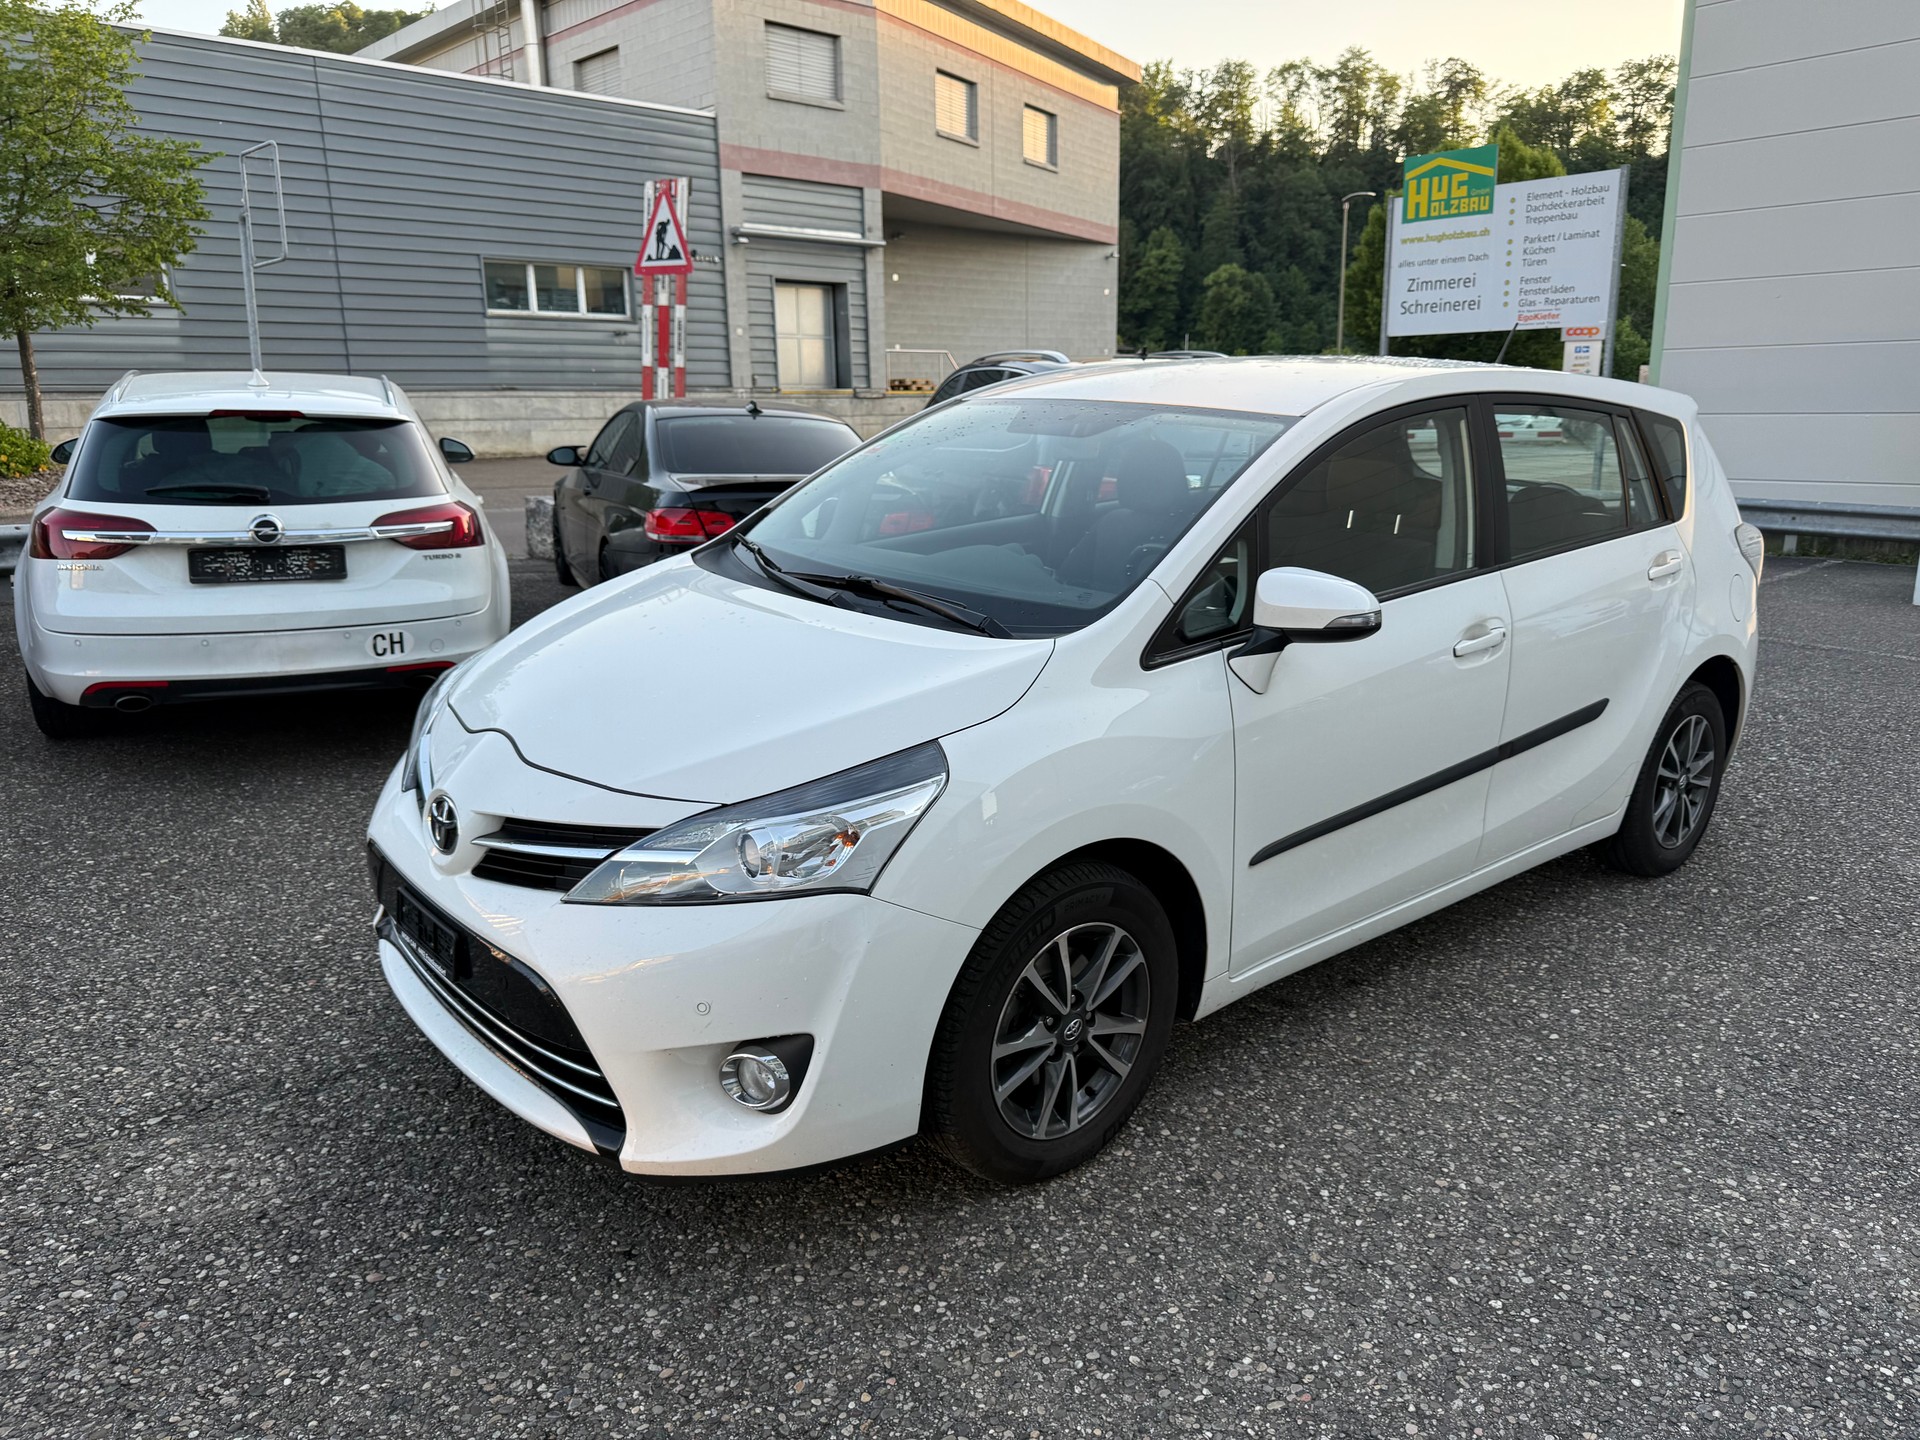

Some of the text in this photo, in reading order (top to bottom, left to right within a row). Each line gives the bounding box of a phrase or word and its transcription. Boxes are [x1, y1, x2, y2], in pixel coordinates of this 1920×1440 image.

[1407, 172, 1469, 219] HUG
[1526, 190, 1563, 202] Element
[1571, 184, 1610, 196] Holzbau
[1525, 195, 1605, 213] Dachdeckerarbeit
[1525, 212, 1578, 225] Treppenbau
[1401, 227, 1490, 245] www.hugholzbau.ch
[1523, 234, 1555, 244] Parkett
[1563, 229, 1600, 241] Laminat
[1522, 245, 1555, 256] Küchen
[1398, 252, 1489, 268] alles unter einem Dach
[1522, 257, 1547, 267] Türen
[1407, 272, 1477, 293] Zimmerei
[1520, 275, 1552, 285] Fenster
[1519, 284, 1575, 296] Fensterläden
[1400, 295, 1481, 315] Schreinerei
[1518, 298, 1537, 308] Glas
[1543, 294, 1600, 308] Reparaturen
[1517, 312, 1560, 322] EgoKiefer
[1566, 327, 1600, 337] coop
[422, 552, 454, 561] TURBO
[373, 631, 405, 657] CH
